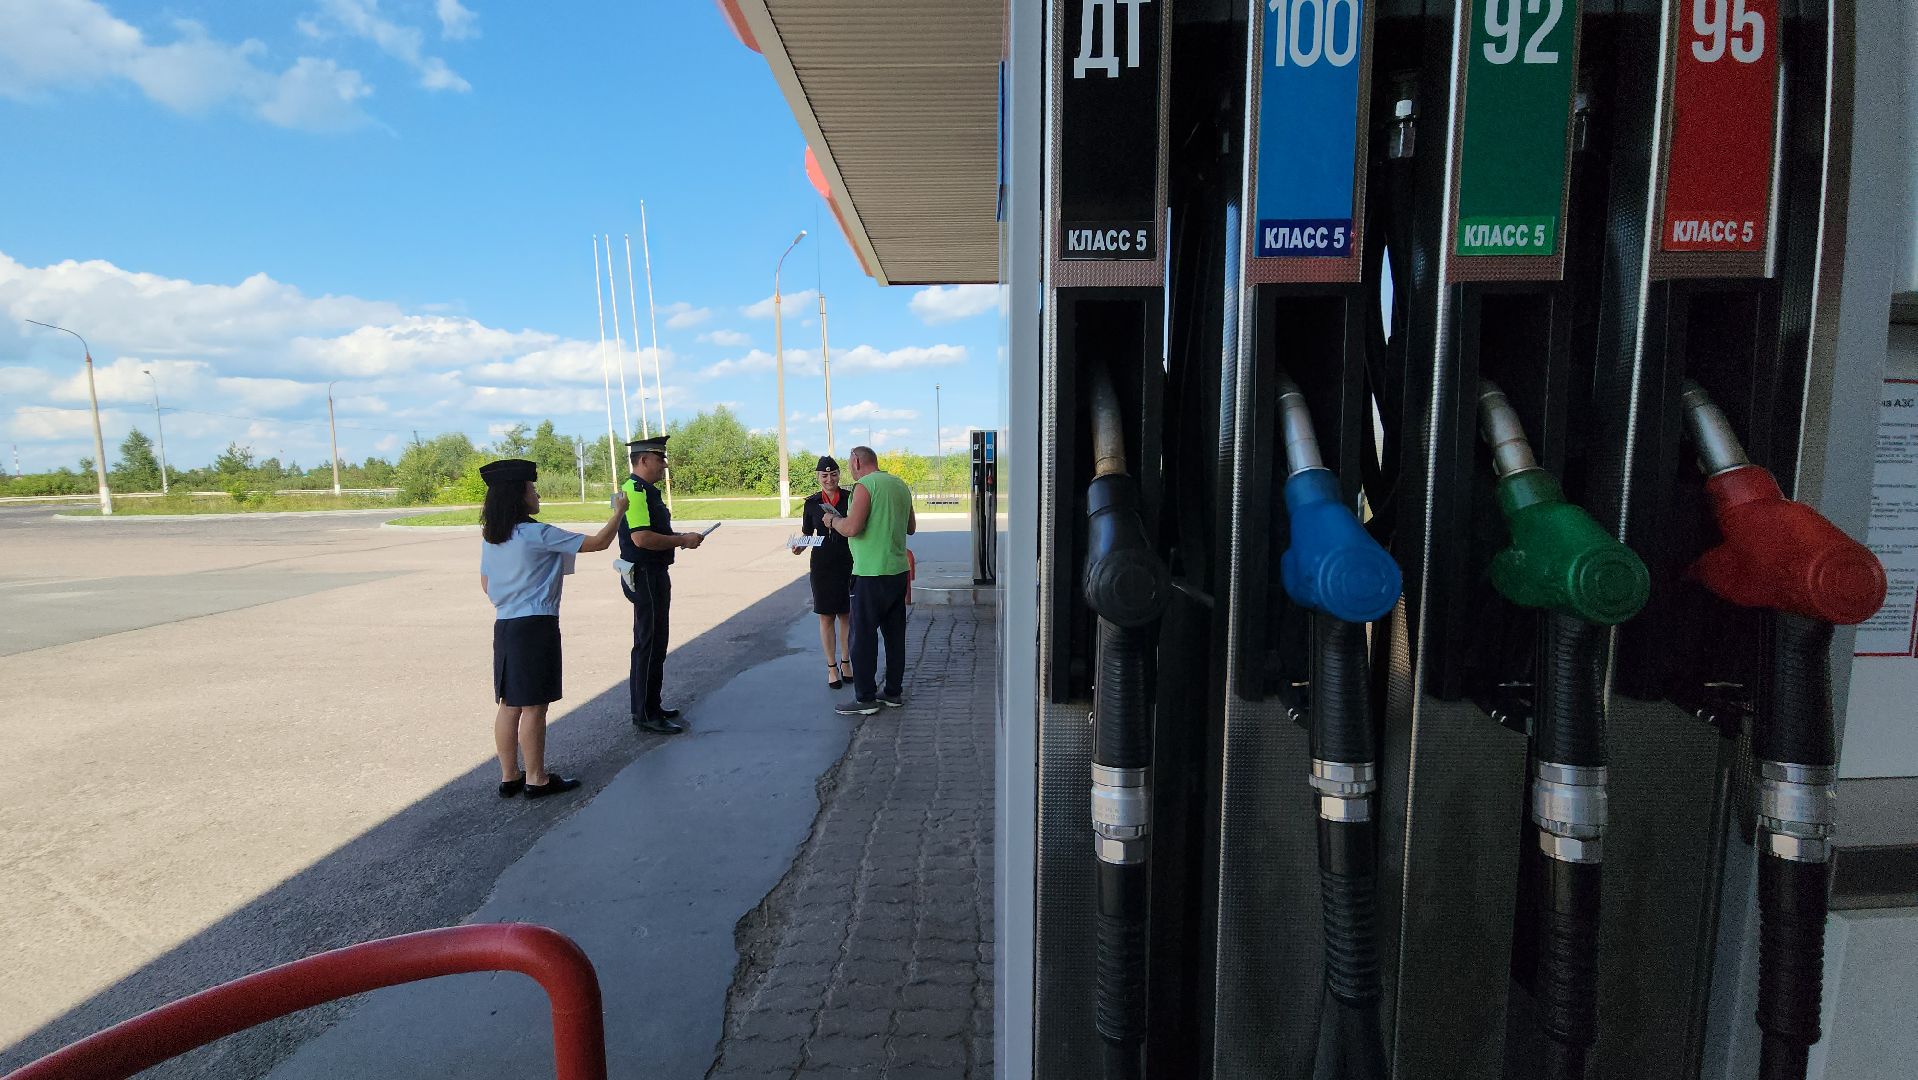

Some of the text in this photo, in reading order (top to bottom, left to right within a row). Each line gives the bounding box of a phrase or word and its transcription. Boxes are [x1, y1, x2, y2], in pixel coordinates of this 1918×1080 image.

[1073, 0, 1152, 79] ДТ
[1268, 0, 1360, 68] 100
[1482, 0, 1563, 65] 92
[1691, 0, 1766, 64] 95
[1068, 229, 1147, 252] КЛАСС 5
[1264, 227, 1345, 249] КЛАСС 5
[1464, 224, 1545, 248] КЛАСС 5
[1672, 220, 1754, 243] КЛАСС 5
[1893, 398, 1915, 408] АЗС
